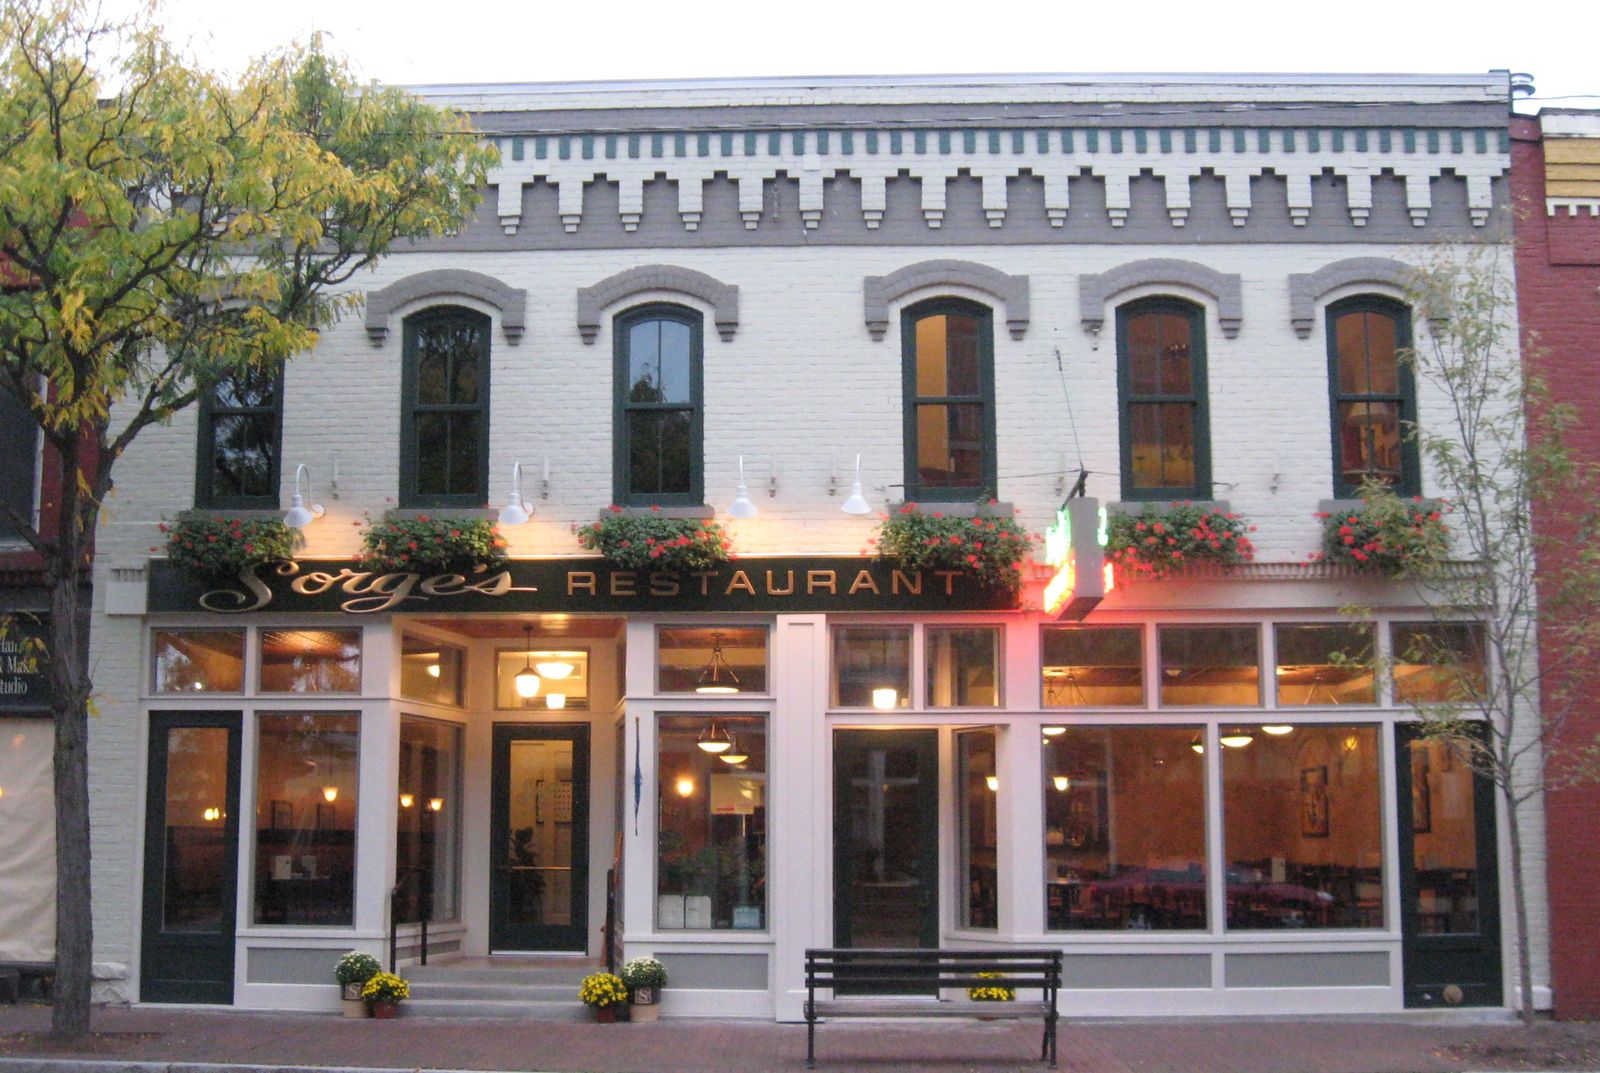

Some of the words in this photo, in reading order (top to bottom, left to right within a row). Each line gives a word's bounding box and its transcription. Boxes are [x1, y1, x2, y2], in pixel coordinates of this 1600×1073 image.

[199, 559, 538, 613] Sorge's
[567, 570, 964, 596] RESTAURANT
[0, 676, 28, 694] tudio
